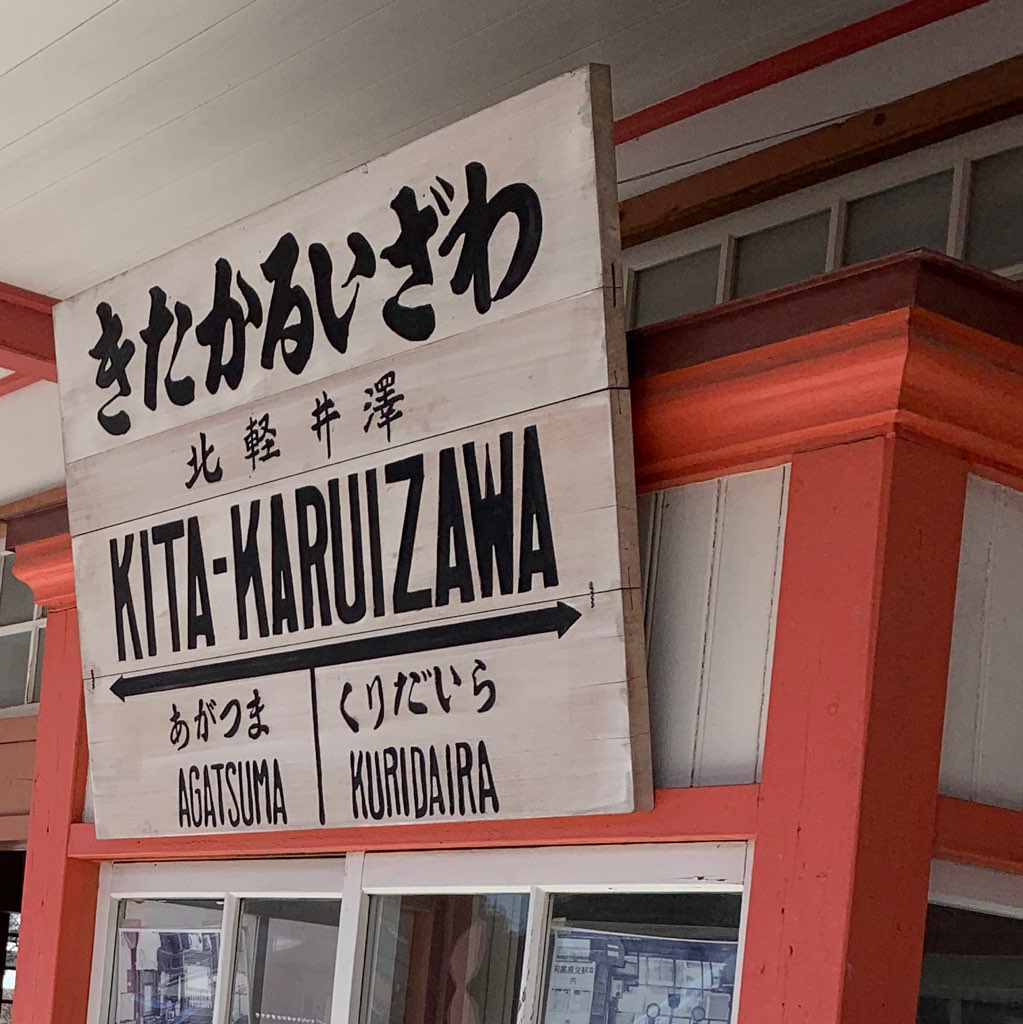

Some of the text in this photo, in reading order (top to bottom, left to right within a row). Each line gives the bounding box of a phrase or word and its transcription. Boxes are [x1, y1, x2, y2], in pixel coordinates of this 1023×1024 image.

[89, 161, 543, 436] きたかるいざわ
[184, 370, 405, 490] 北軽井澤
[109, 425, 560, 662] KITA-KARUIZAWA
[168, 689, 270, 751] あがつま
[339, 658, 497, 733] くりだいら
[177, 757, 288, 828] AGATSUMA
[350, 739, 500, 820] KURIDAIRA
